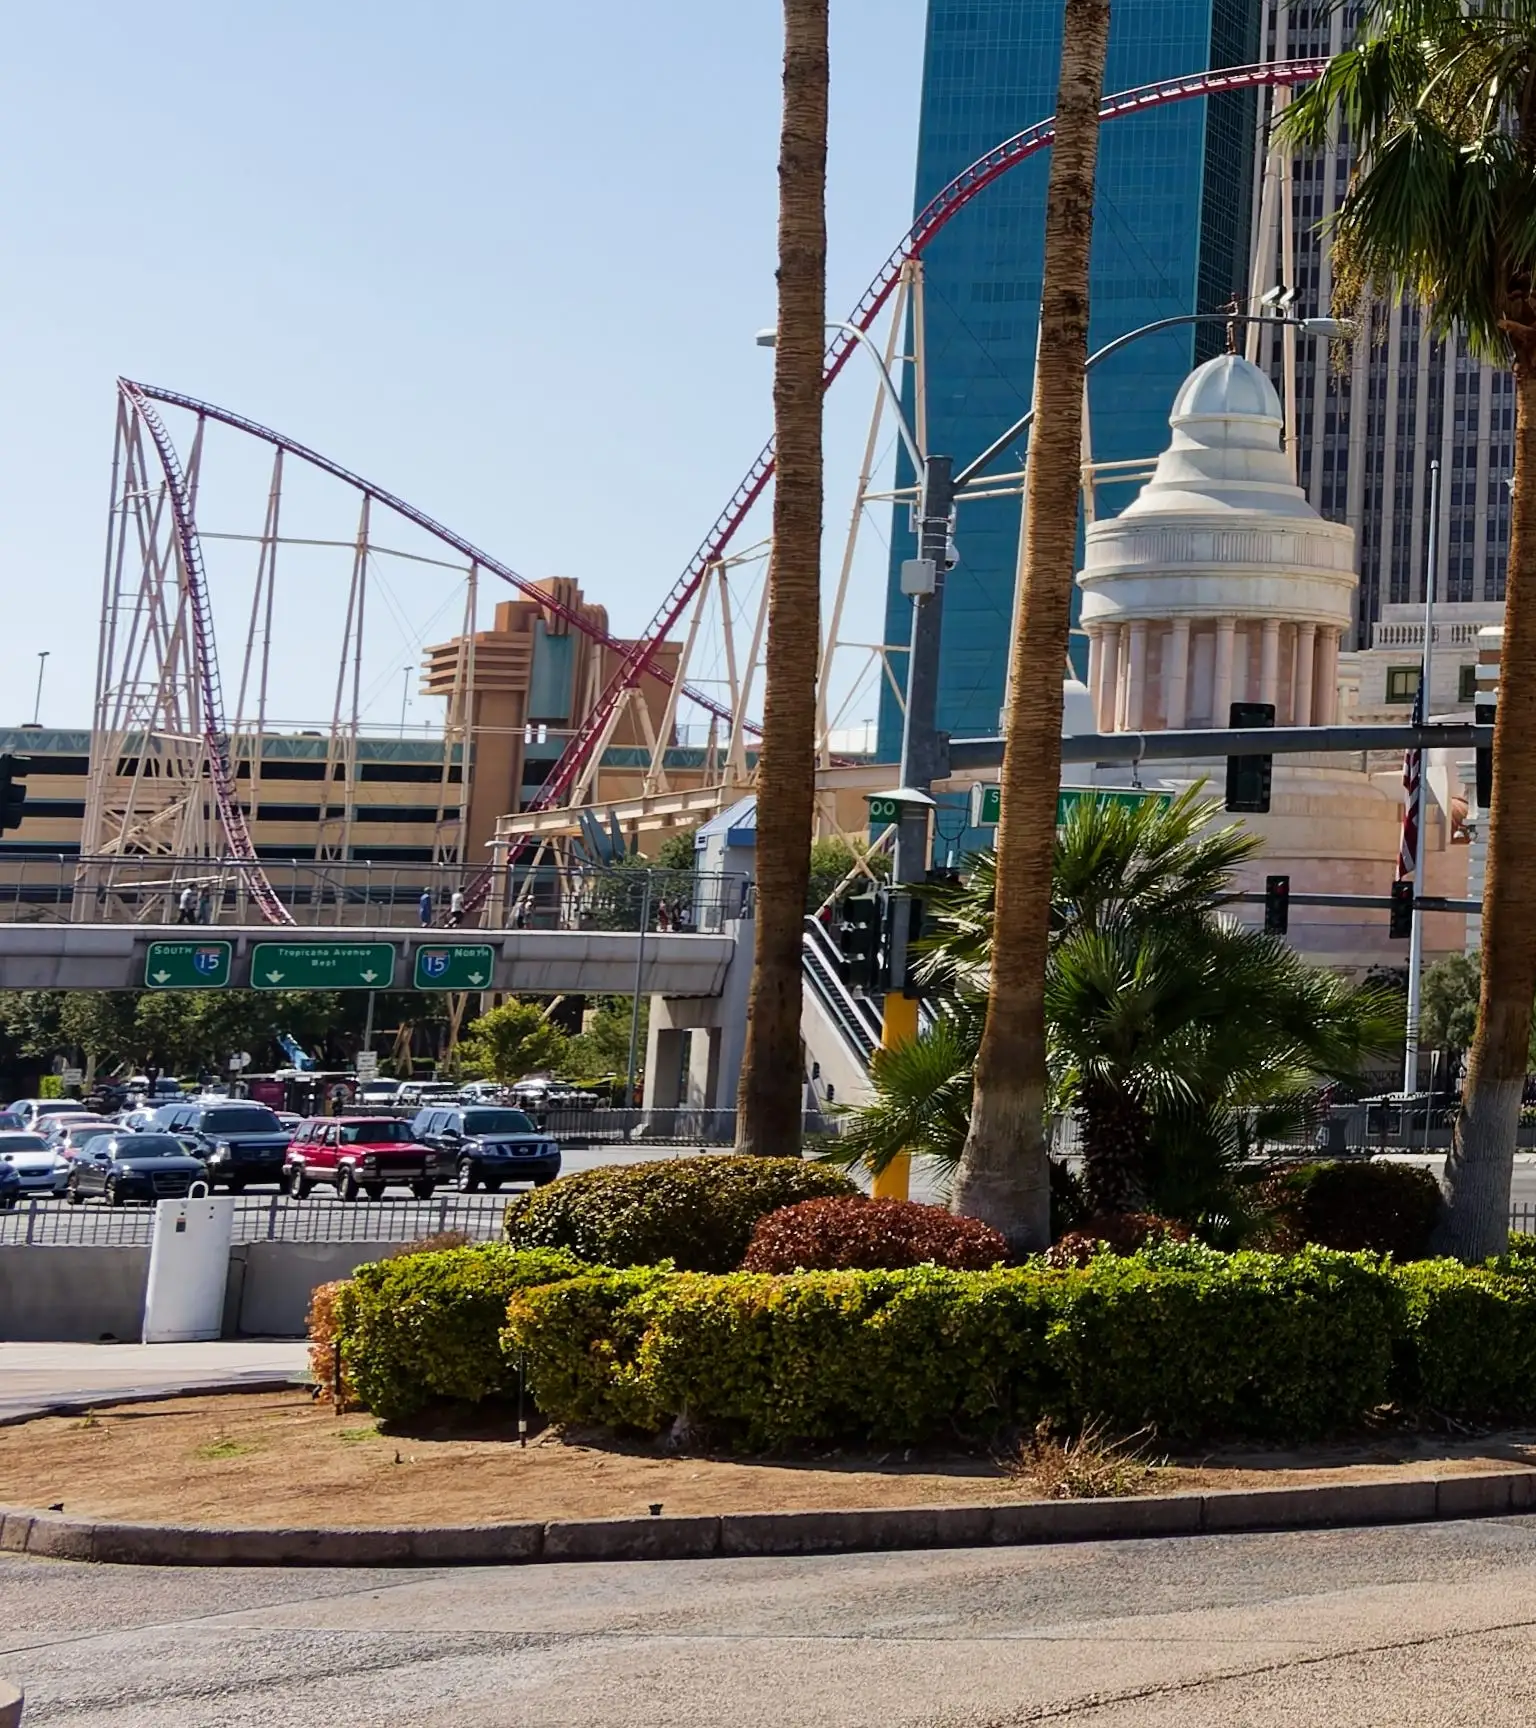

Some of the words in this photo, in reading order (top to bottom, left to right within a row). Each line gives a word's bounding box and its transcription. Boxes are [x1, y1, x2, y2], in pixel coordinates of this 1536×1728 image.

[154, 946, 193, 955] SOUTH
[200, 954, 220, 969] 15
[278, 948, 329, 957] Tropicana
[334, 948, 372, 956] Avenue
[427, 957, 445, 971] 15
[454, 947, 489, 957] NORTH
[311, 959, 337, 967] West
